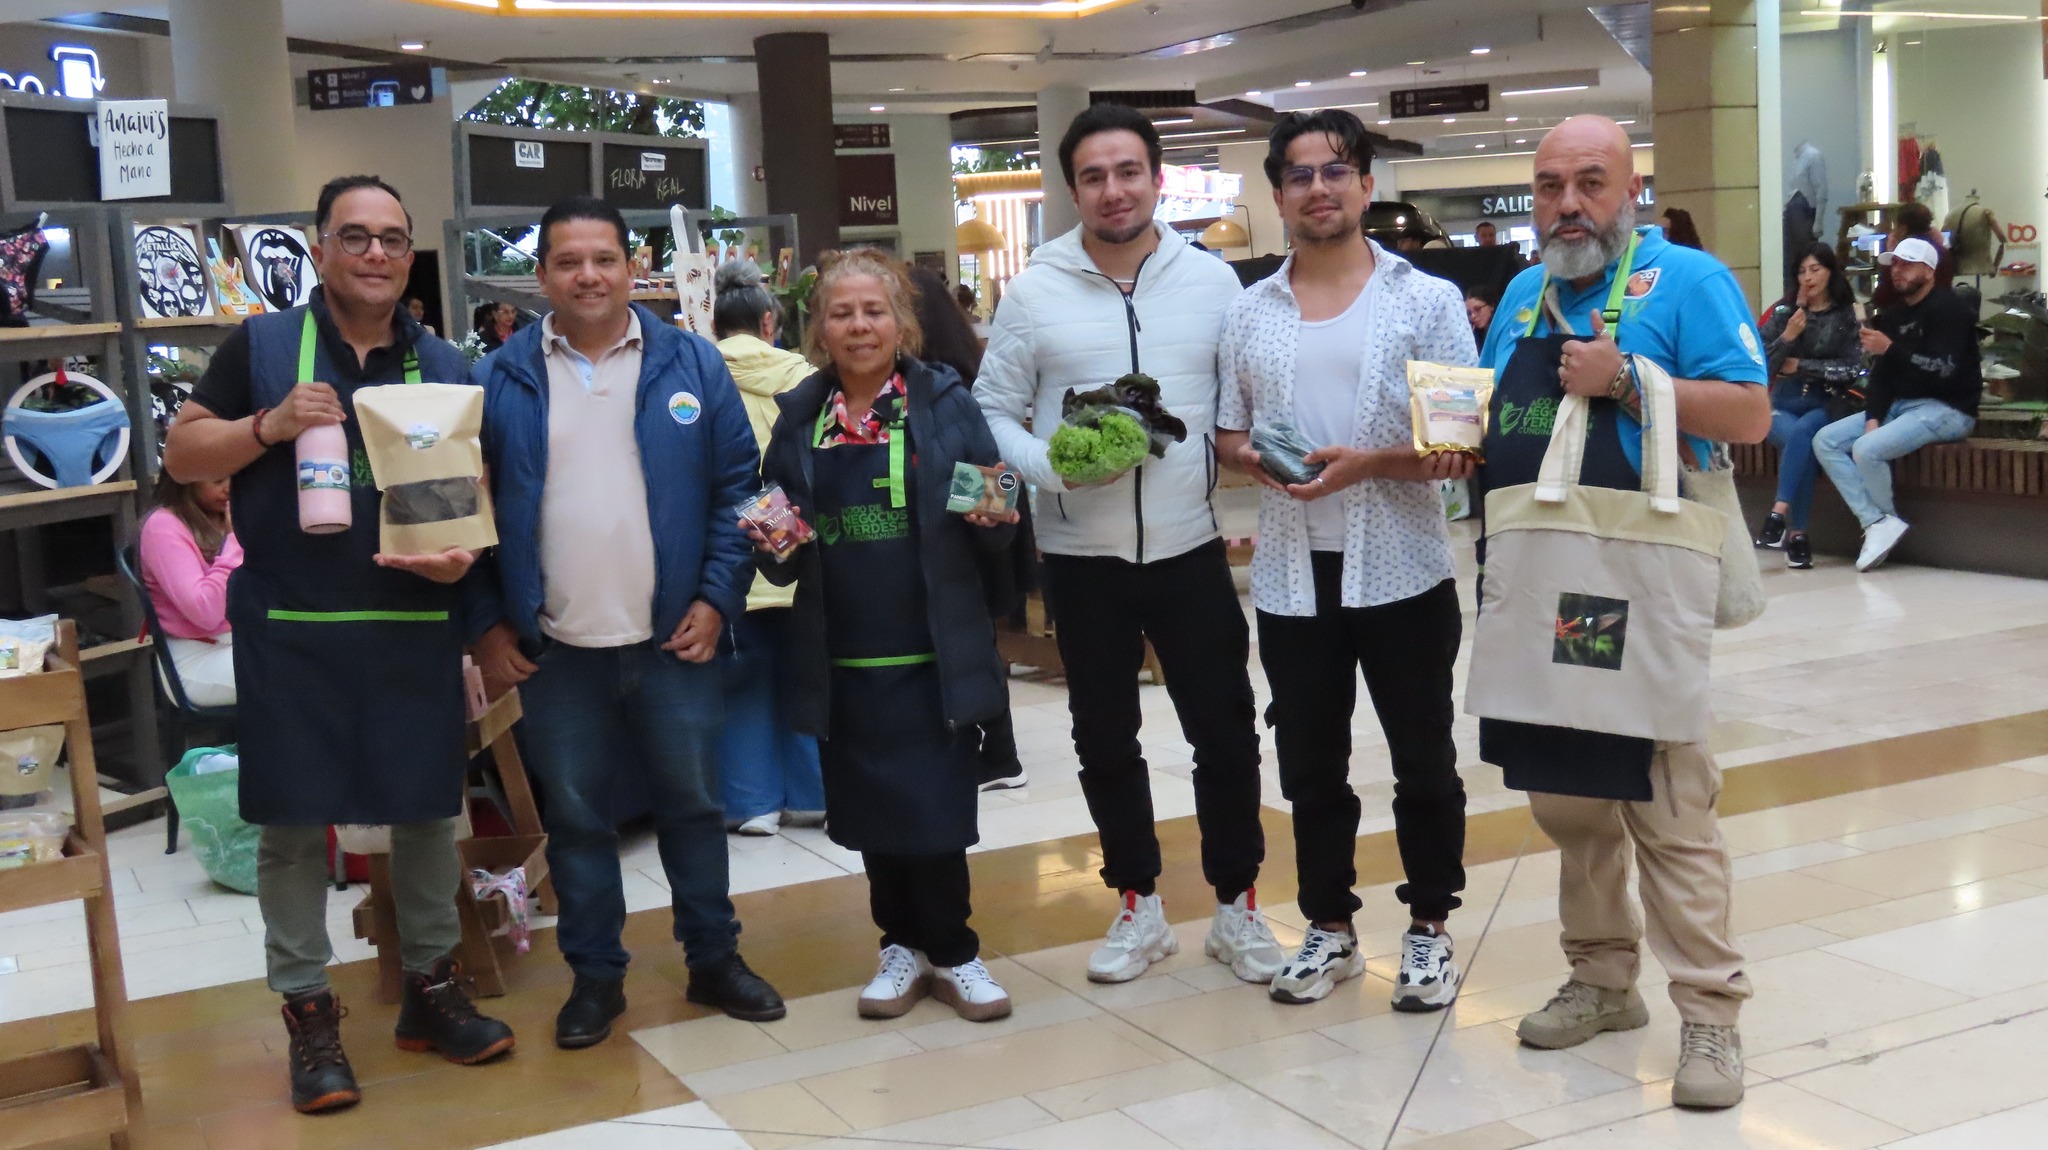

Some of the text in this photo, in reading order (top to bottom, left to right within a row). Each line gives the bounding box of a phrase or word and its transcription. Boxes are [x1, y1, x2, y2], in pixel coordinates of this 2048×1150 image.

[114, 140, 154, 160] Hecho a
[518, 142, 541, 160] CAR
[119, 164, 151, 184] Mano
[610, 168, 685, 201] FLORA REAL
[850, 195, 892, 212] Nivel
[1482, 195, 1534, 215] SALID
[868, 503, 882, 512] DE
[842, 510, 908, 525] NEGOCIOS
[843, 521, 897, 536] VERDES
